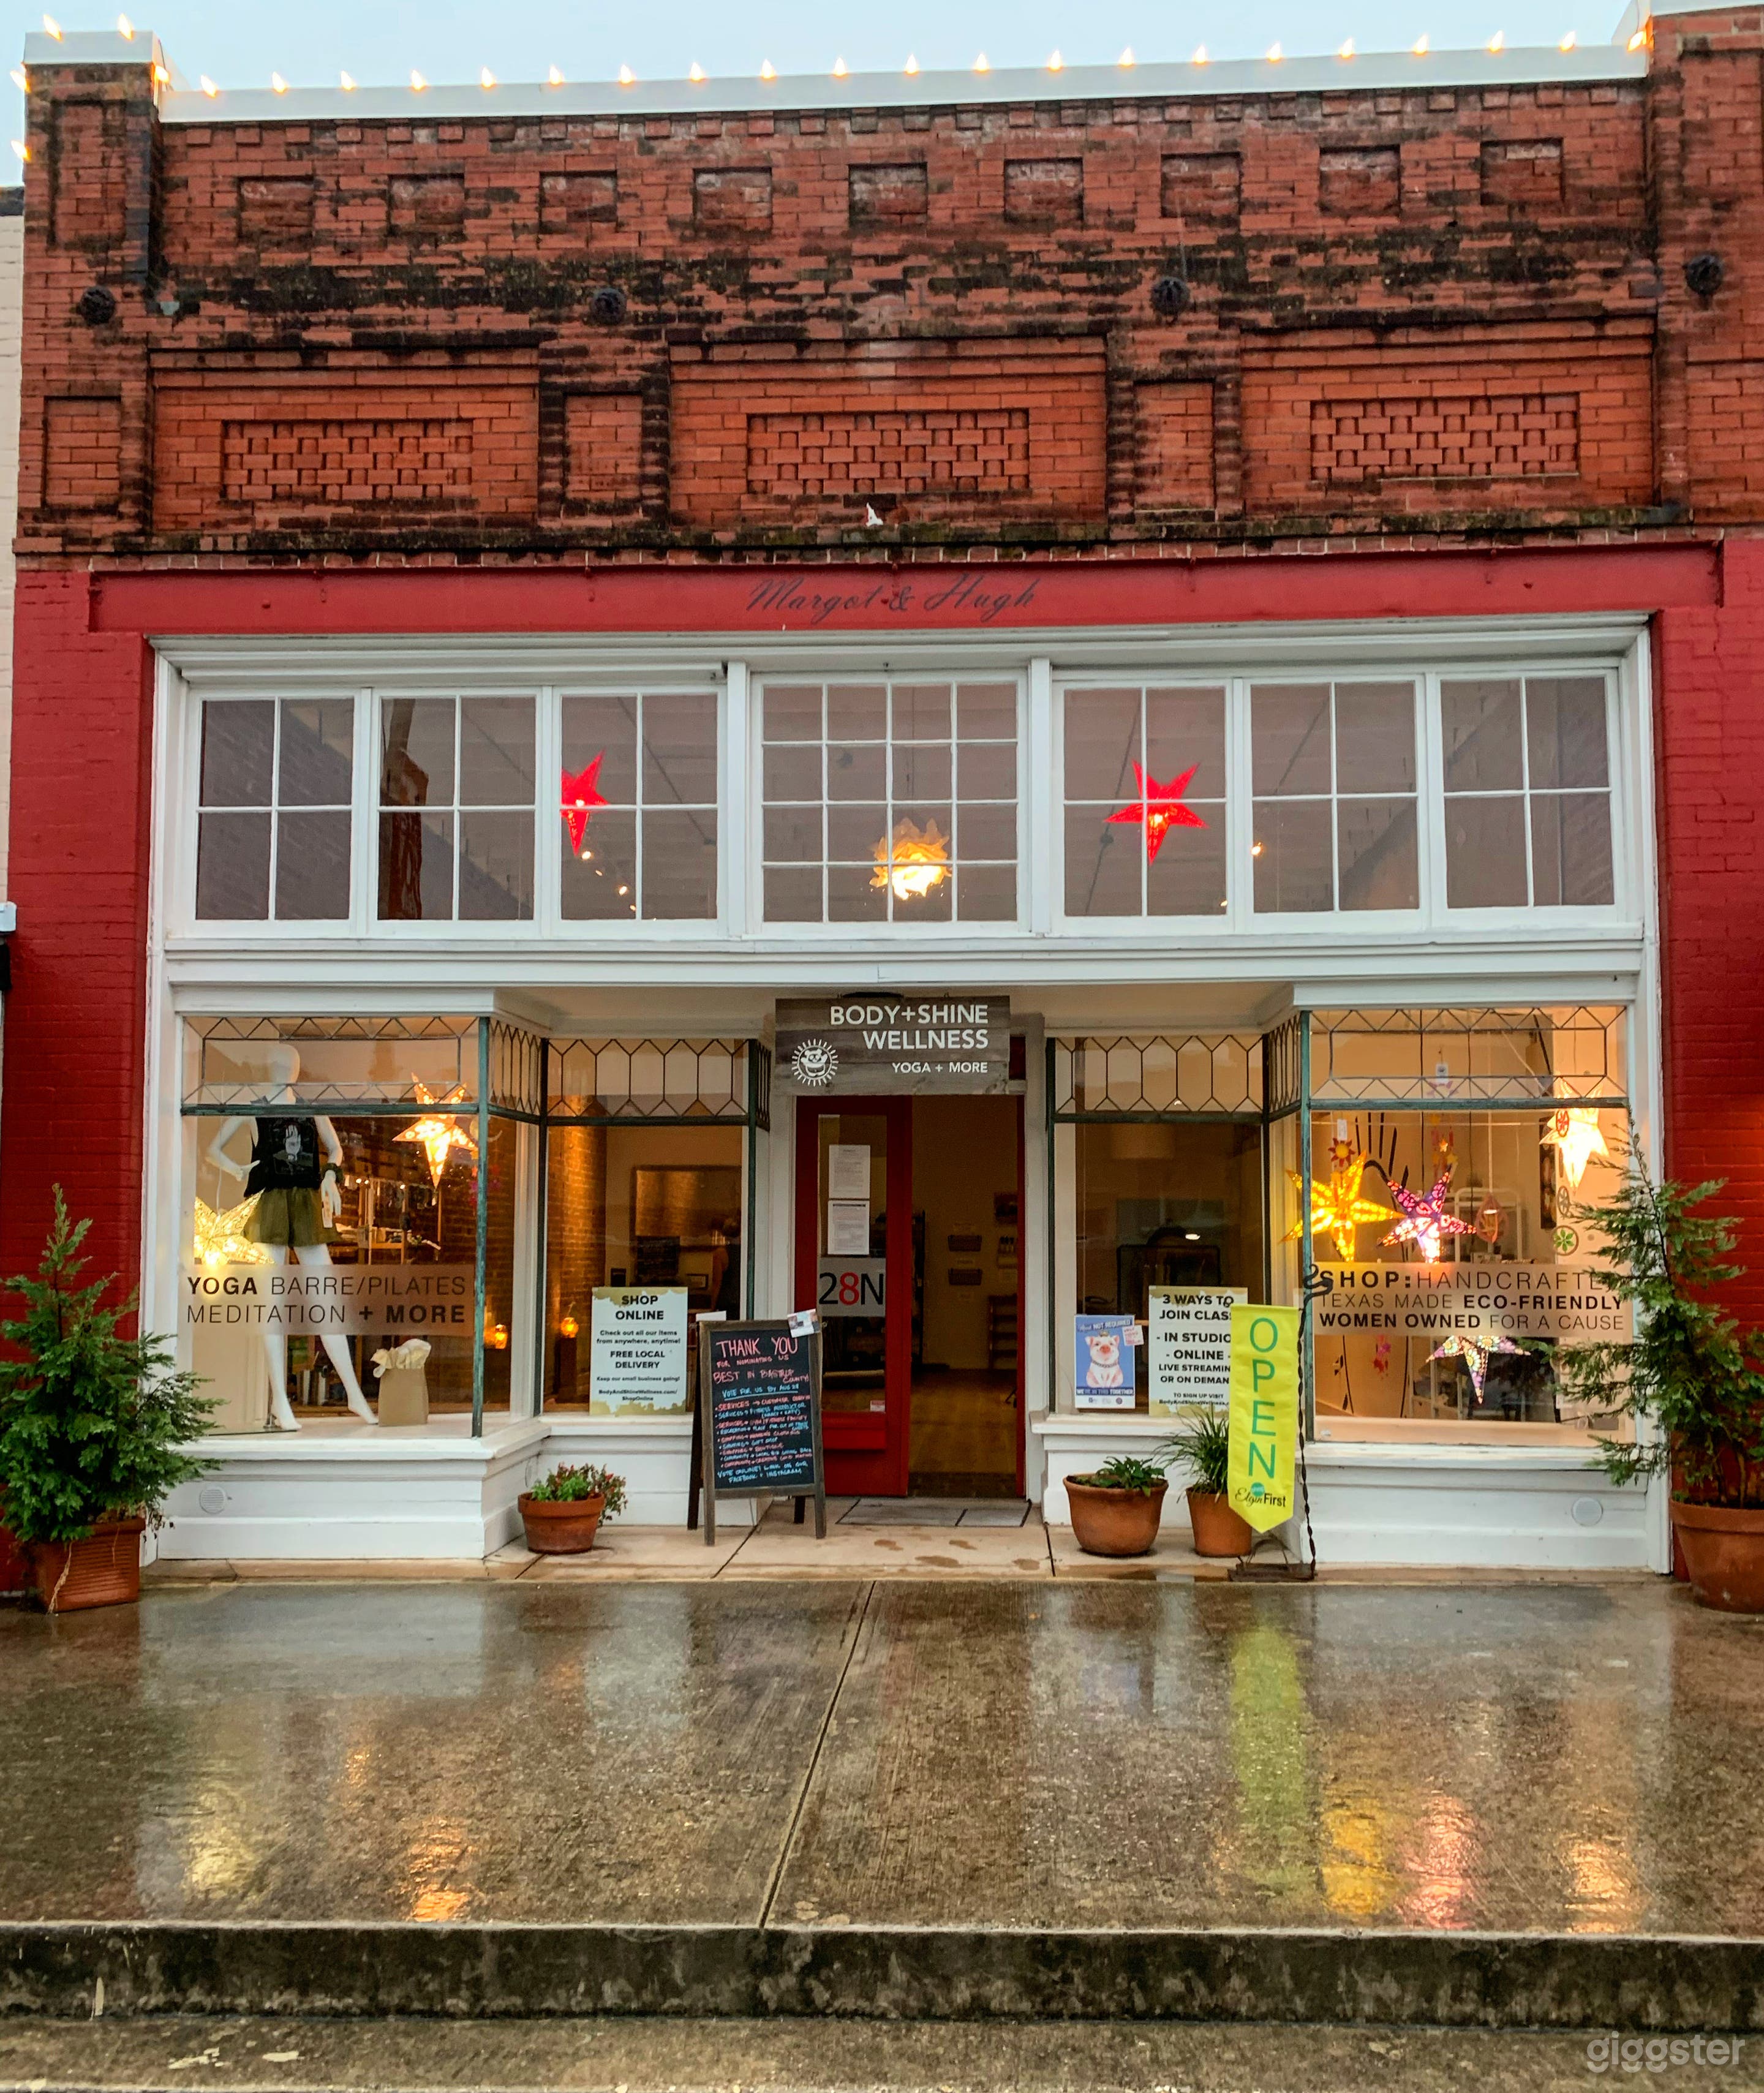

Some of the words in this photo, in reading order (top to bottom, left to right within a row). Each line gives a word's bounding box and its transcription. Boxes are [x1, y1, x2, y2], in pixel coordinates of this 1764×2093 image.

[747, 576, 883, 624] Margot
[888, 586, 915, 611] &
[924, 572, 1040, 624] Hugh
[830, 1004, 989, 1025] BODY+SHINE
[862, 1029, 989, 1049] WELLNESS
[891, 1062, 932, 1074] YOGA
[935, 1064, 944, 1073] +
[949, 1062, 989, 1073] MORE
[187, 1277, 258, 1295] YOGA
[271, 1276, 466, 1295] BARRE/PILATES
[818, 1271, 884, 1306] 28N
[622, 1295, 658, 1305] SHOP
[1163, 1294, 1170, 1305] 3
[1174, 1295, 1212, 1305] WAYS
[1216, 1295, 1235, 1307] TO
[1321, 1293, 1384, 1308] TEXAS
[1395, 1293, 1453, 1308] MADE
[1464, 1295, 1622, 1310] ECO-FRIENDLY
[187, 1305, 345, 1324] MEDITATION
[359, 1307, 373, 1321] +
[386, 1305, 466, 1324] MORE
[616, 1311, 664, 1320] ONLINE
[1159, 1310, 1191, 1320] JOIN
[1194, 1310, 1231, 1320] CLAS
[1320, 1313, 1397, 1328] WOMEN
[1404, 1314, 1480, 1328] OWNED
[1490, 1315, 1529, 1330] FOR
[1537, 1315, 1550, 1330] A
[1558, 1315, 1624, 1330] CAUSE
[1164, 1332, 1178, 1343] IN
[716, 1338, 761, 1357] THANK
[772, 1337, 798, 1354] YOU
[1174, 1349, 1224, 1360] ONLINE
[737, 1356, 772, 1365] NOMINATING
[714, 1371, 740, 1384] BEST
[1248, 1316, 1278, 1479] OPEN
[718, 1401, 750, 1411] SERVICES
